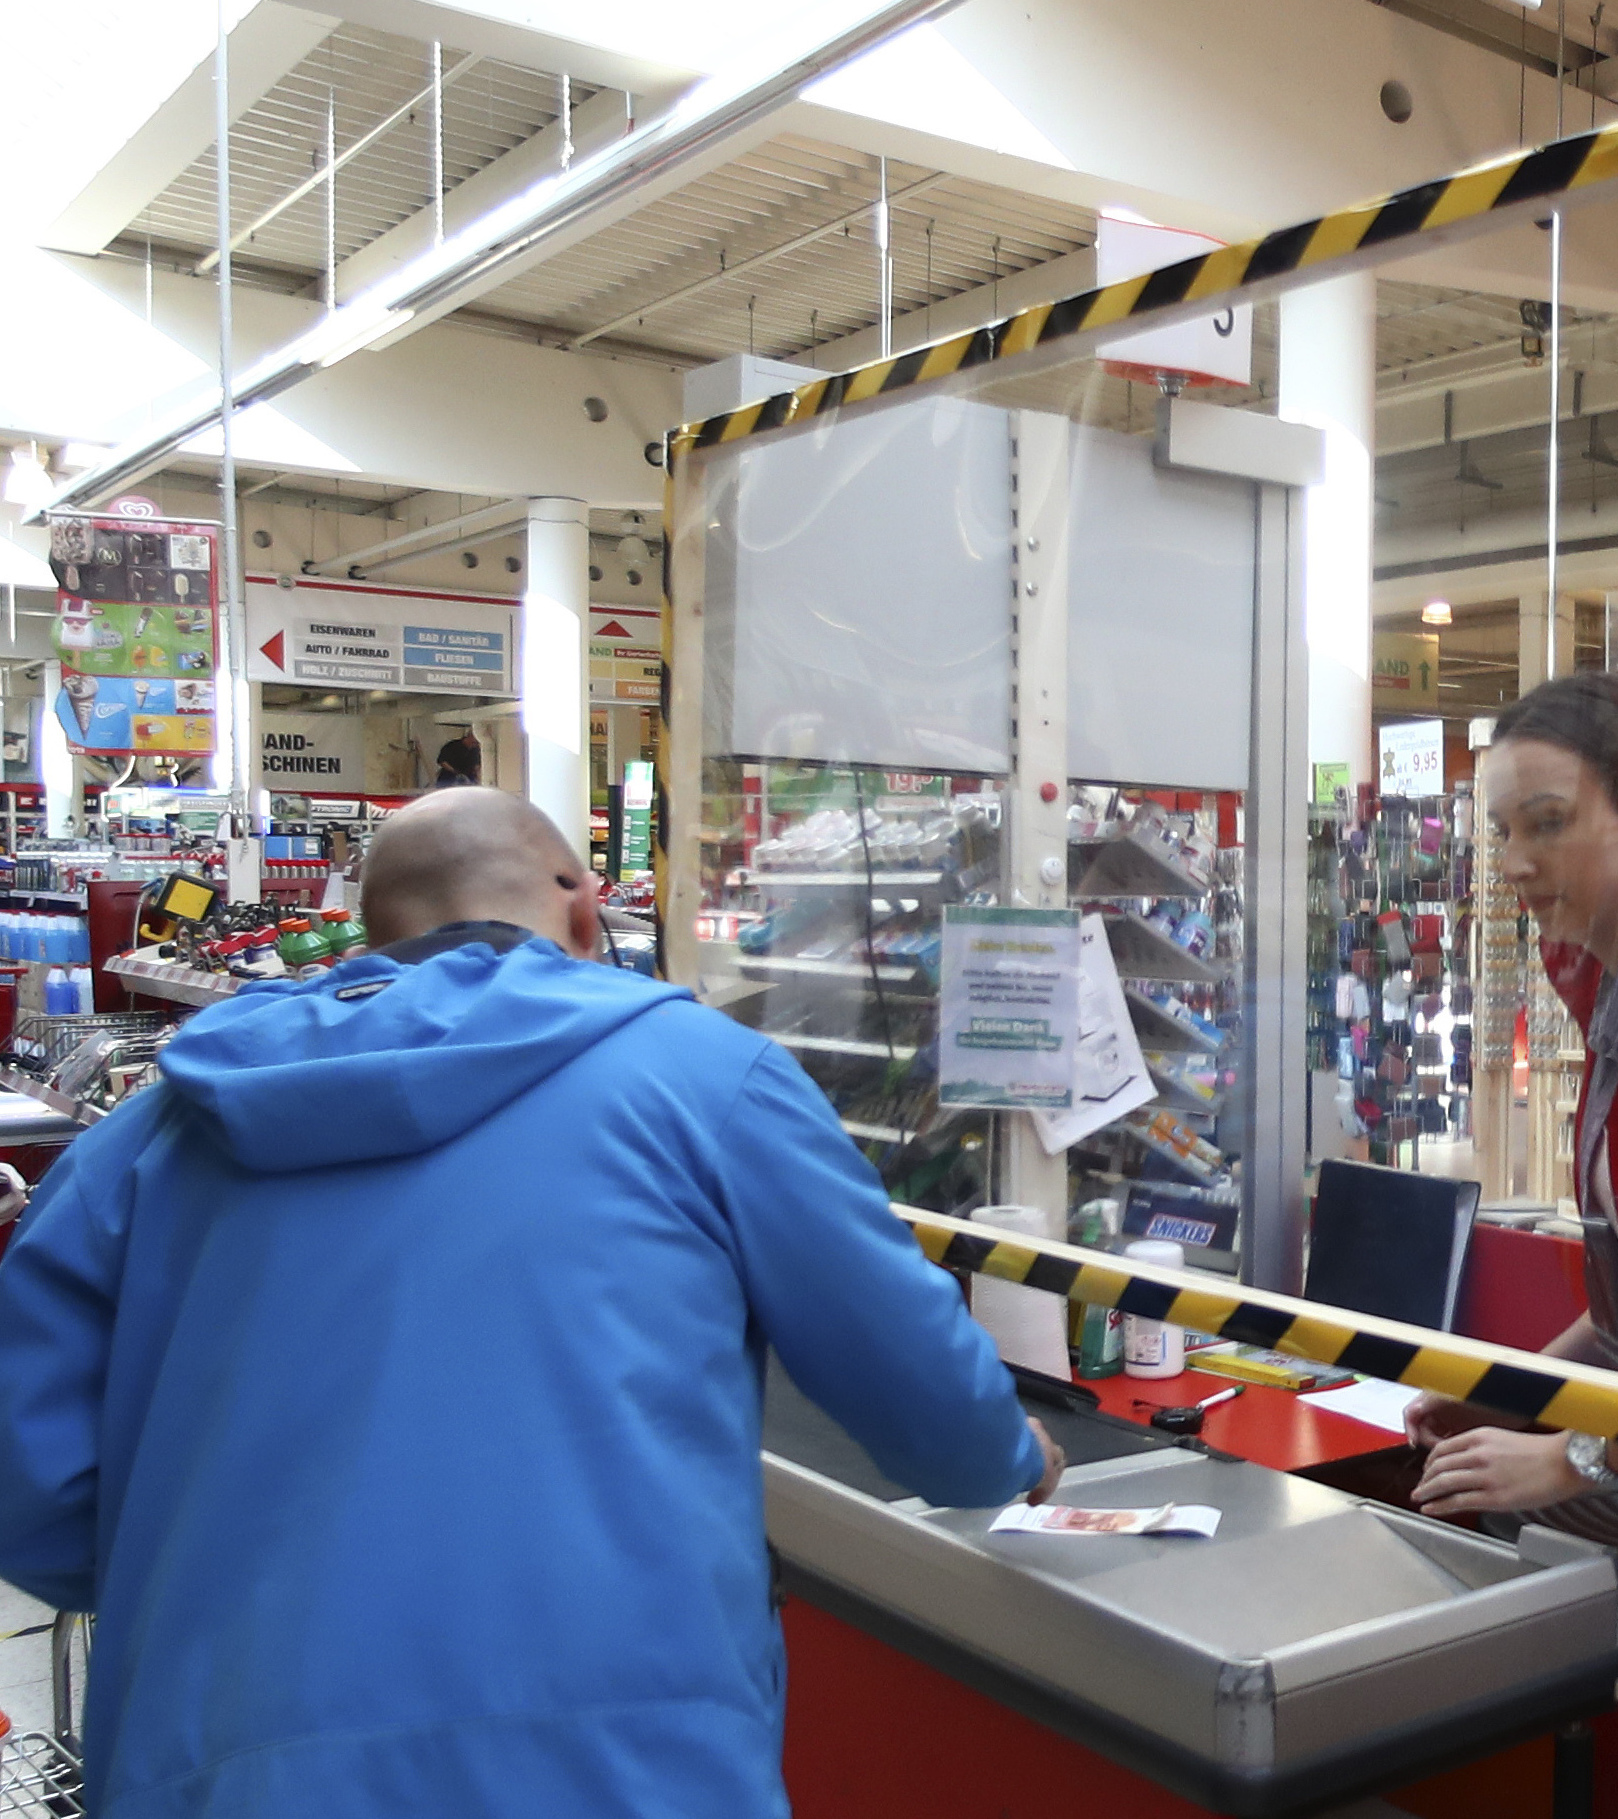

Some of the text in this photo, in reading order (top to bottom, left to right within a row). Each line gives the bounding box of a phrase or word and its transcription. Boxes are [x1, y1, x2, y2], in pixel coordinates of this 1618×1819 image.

[310, 624, 376, 638] EISENWAREN
[419, 632, 440, 643] BAD
[306, 644, 332, 655] AUTO
[342, 646, 390, 659] FAHRRAD
[262, 733, 315, 750] AND-
[1413, 750, 1438, 775] 9,95
[1149, 1215, 1216, 1245] SNICKERS
